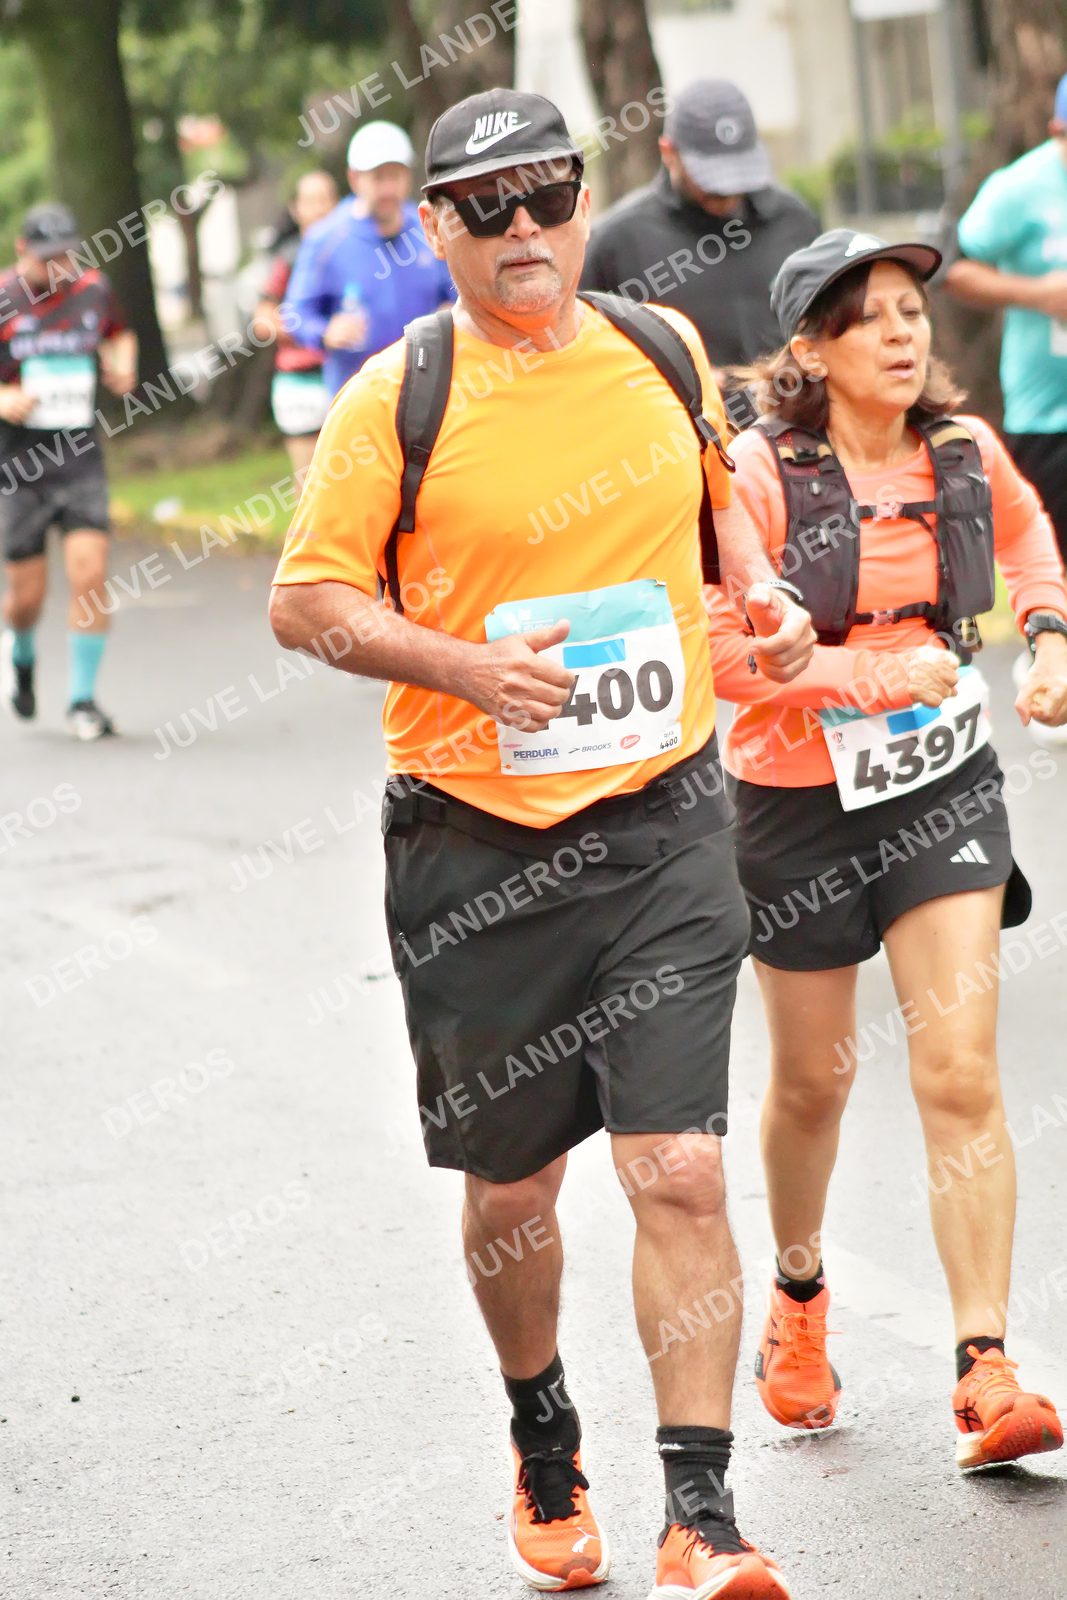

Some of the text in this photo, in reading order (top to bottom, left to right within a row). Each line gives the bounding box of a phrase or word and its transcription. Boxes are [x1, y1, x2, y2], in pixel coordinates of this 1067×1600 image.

[473, 111, 518, 141] NIKE
[538, 660, 673, 731] 400
[513, 748, 559, 759] PERDURA
[582, 742, 612, 753] BROOKS
[660, 736, 678, 750] 4400
[854, 703, 981, 794] 4397
